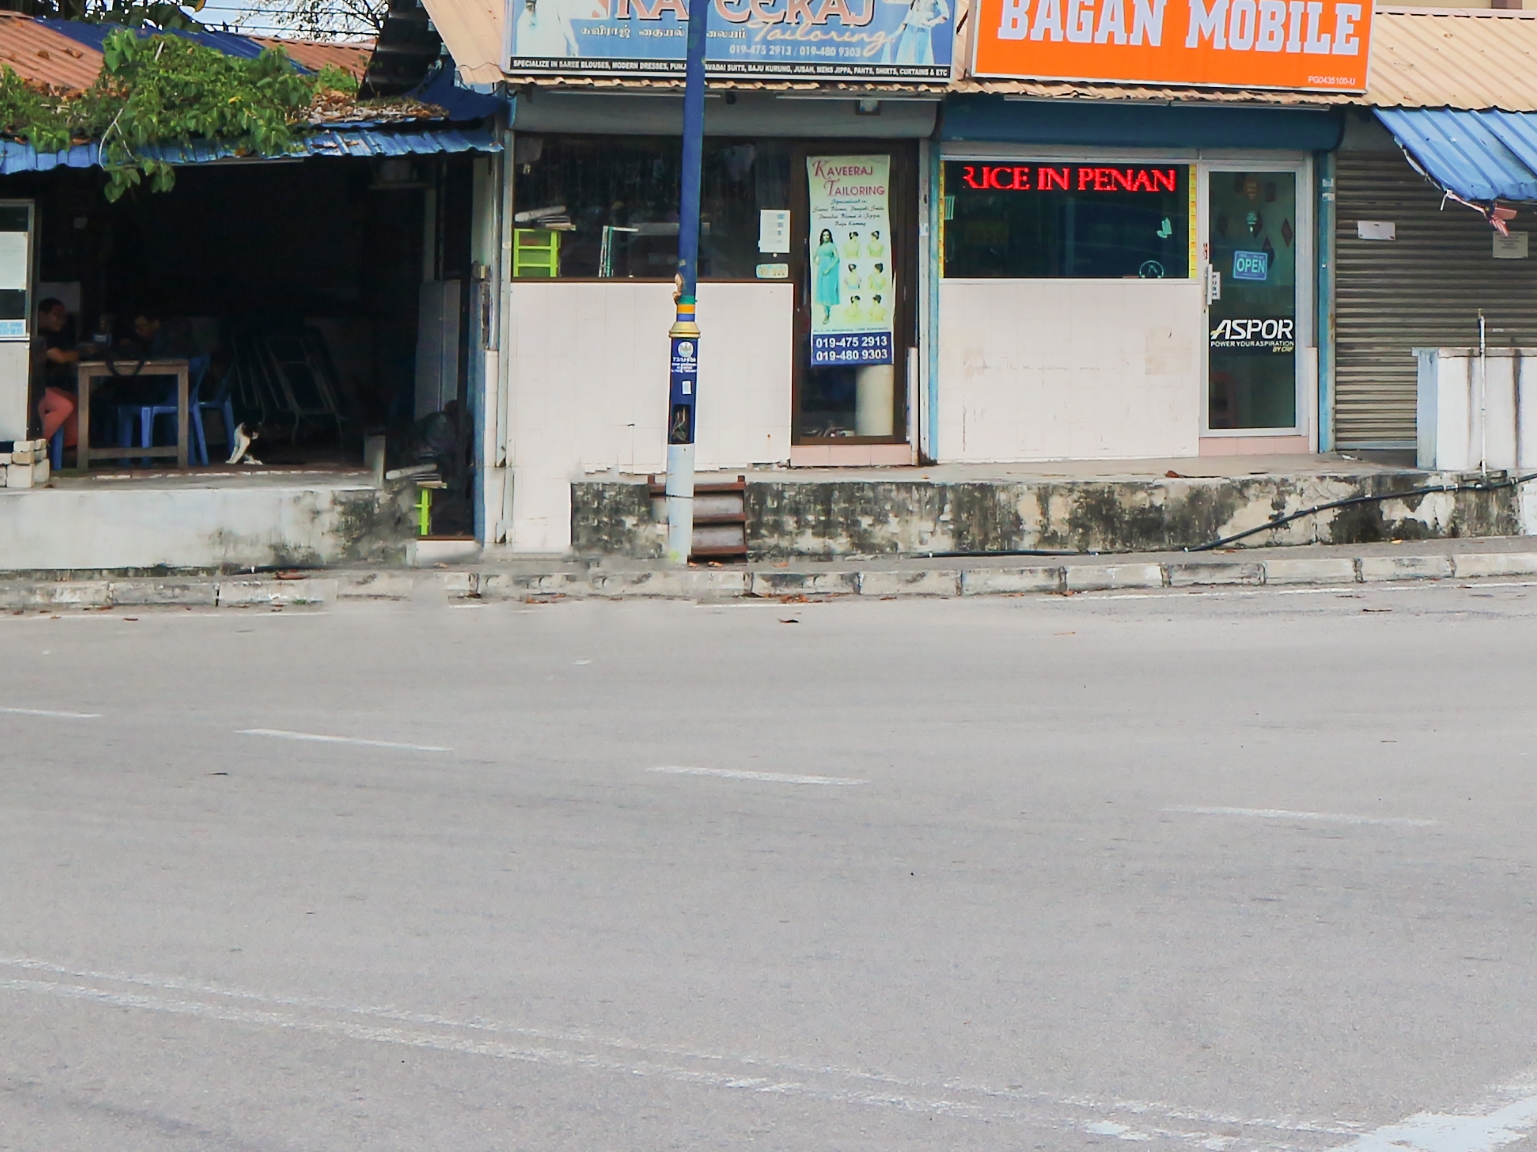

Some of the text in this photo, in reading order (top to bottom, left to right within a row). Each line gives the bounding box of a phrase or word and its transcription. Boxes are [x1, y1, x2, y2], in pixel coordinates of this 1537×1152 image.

[746, 17, 886, 58] Tailoring
[729, 44, 766, 55] 019-475
[769, 45, 792, 56] 2913
[799, 46, 836, 56] 019-480
[838, 46, 861, 57] 9303
[513, 60, 550, 69] SPECIALIZE
[551, 60, 559, 68] IN
[559, 60, 580, 69] SAREE
[612, 61, 639, 70] MODERN
[748, 65, 764, 73] BAJU
[899, 68, 929, 76] CURTAINS
[936, 68, 947, 77] ETC
[812, 160, 873, 179] KAVEERAJ
[824, 179, 885, 196] TAILORING
[1037, 167, 1070, 191] IN
[1078, 168, 1175, 192] PENAN
[1236, 258, 1266, 274] OPEN
[1210, 319, 1293, 339] ASPOR
[816, 336, 887, 348] 019-475 2913
[816, 349, 888, 361] 019-480 9303
